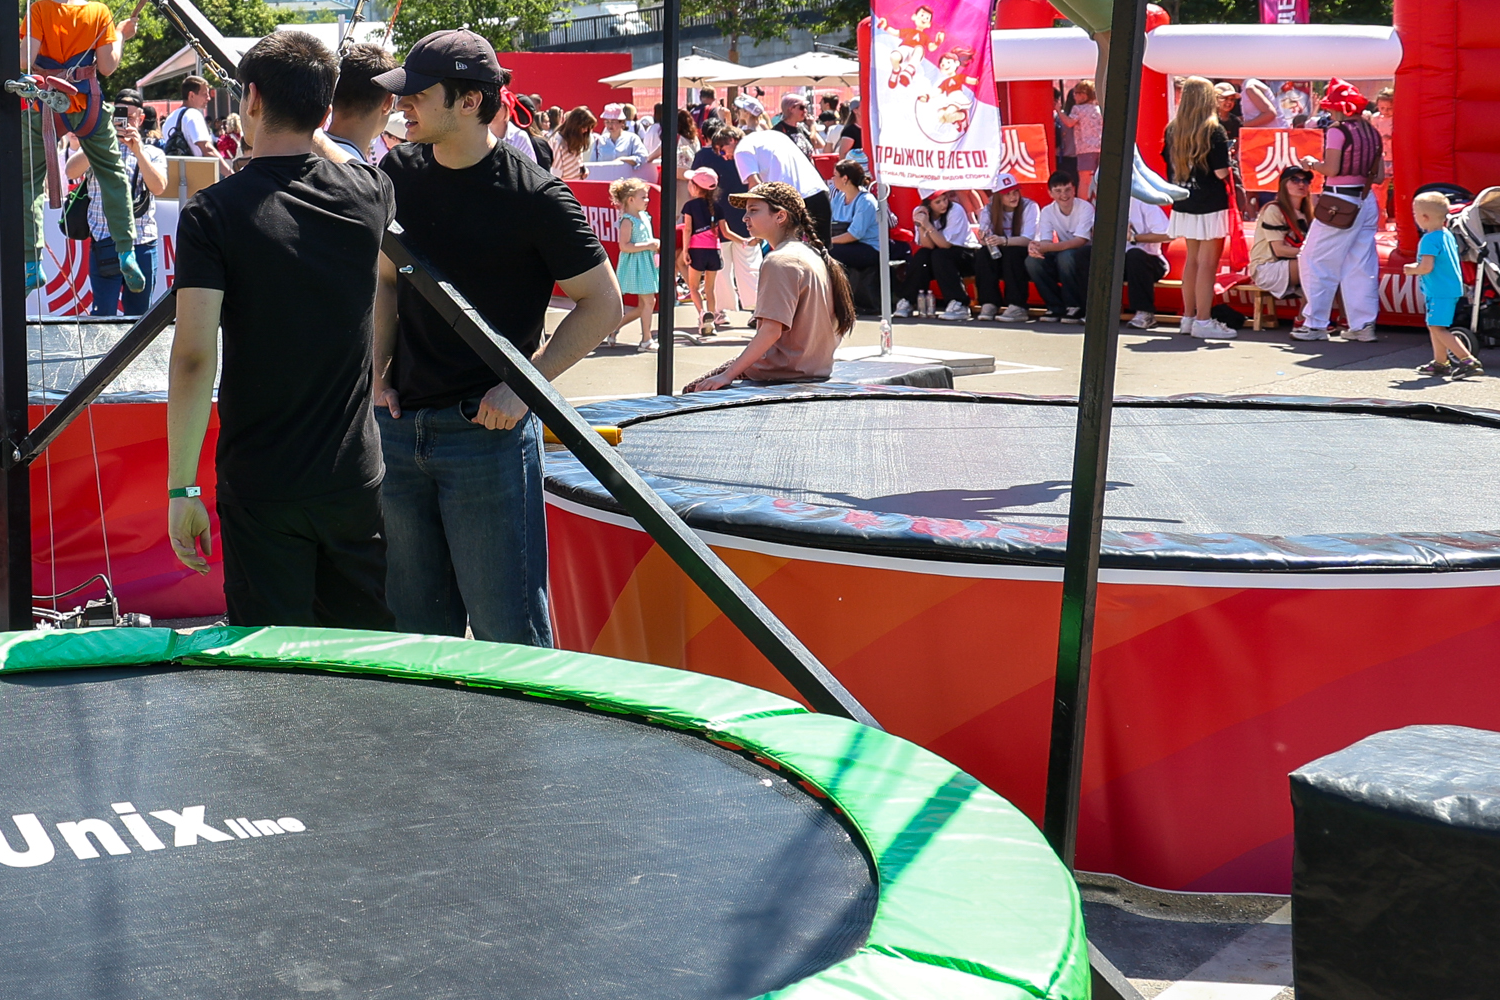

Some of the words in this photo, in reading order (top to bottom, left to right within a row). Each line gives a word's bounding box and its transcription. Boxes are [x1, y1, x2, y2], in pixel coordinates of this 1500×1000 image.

[875, 145, 934, 169] ПРЫЖОК
[937, 150, 945, 169] В
[947, 150, 988, 169] ЛЕТО!
